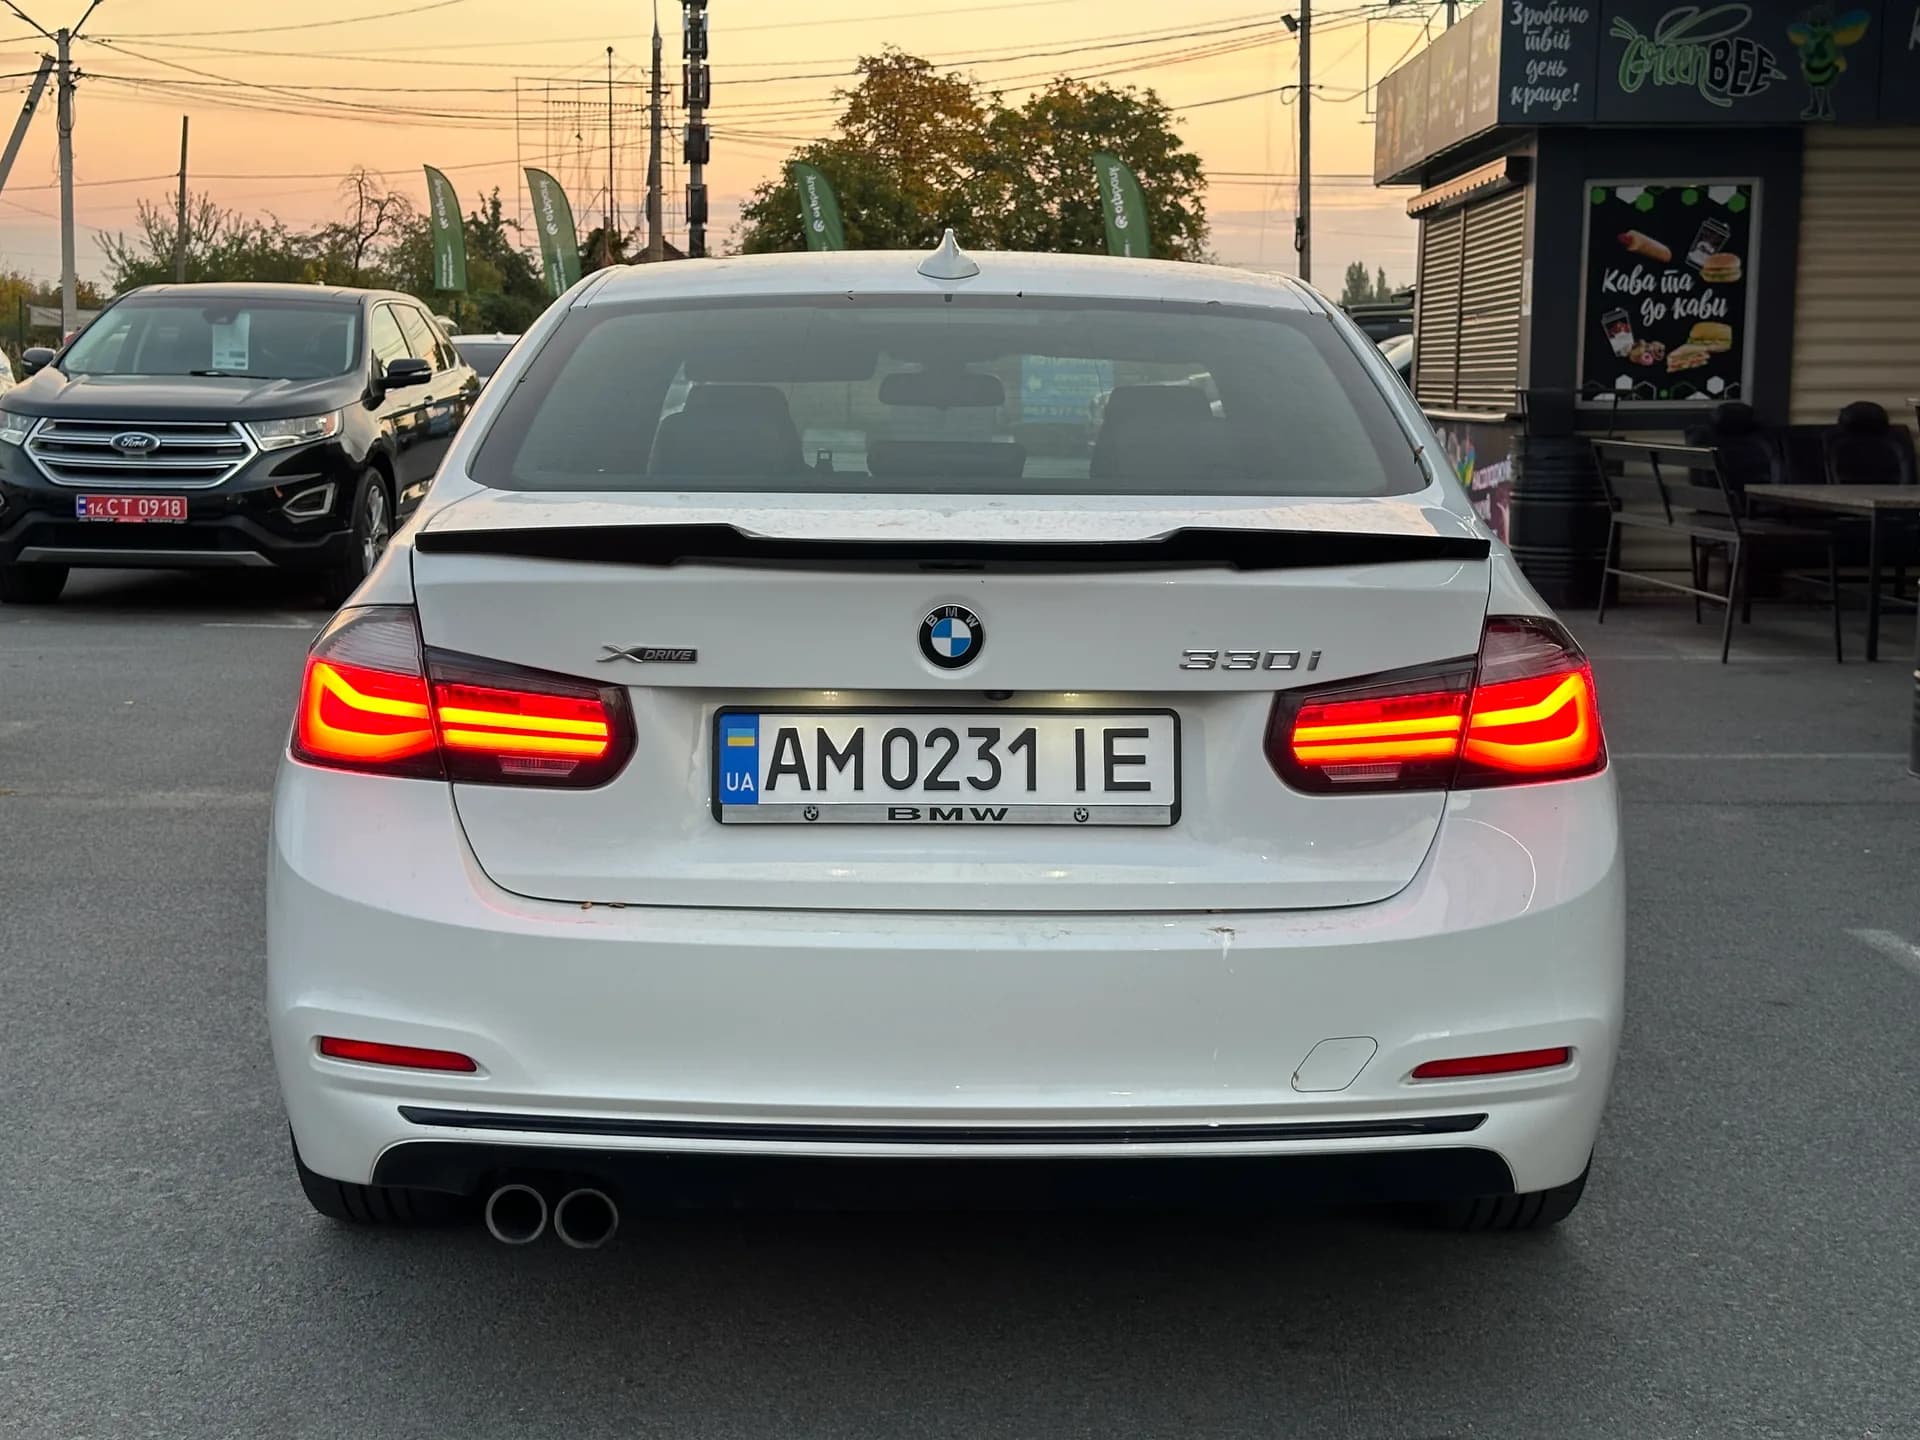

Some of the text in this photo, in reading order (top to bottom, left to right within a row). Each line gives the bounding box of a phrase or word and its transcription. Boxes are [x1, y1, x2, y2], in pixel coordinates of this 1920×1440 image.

[1510, 1, 1589, 34] Зробимо
[1524, 27, 1571, 51] твій
[1525, 58, 1568, 84] день
[1511, 82, 1580, 114] краще!
[1602, 264, 1693, 296] Кава та
[1640, 288, 1728, 327] до кави
[121, 435, 148, 447] Ford
[139, 499, 181, 516] 0918
[925, 607, 979, 628] BMW
[1179, 649, 1322, 672] 330i
[1075, 728, 1151, 791] IE
[726, 773, 755, 792] UA
[887, 808, 1009, 822] BMW
